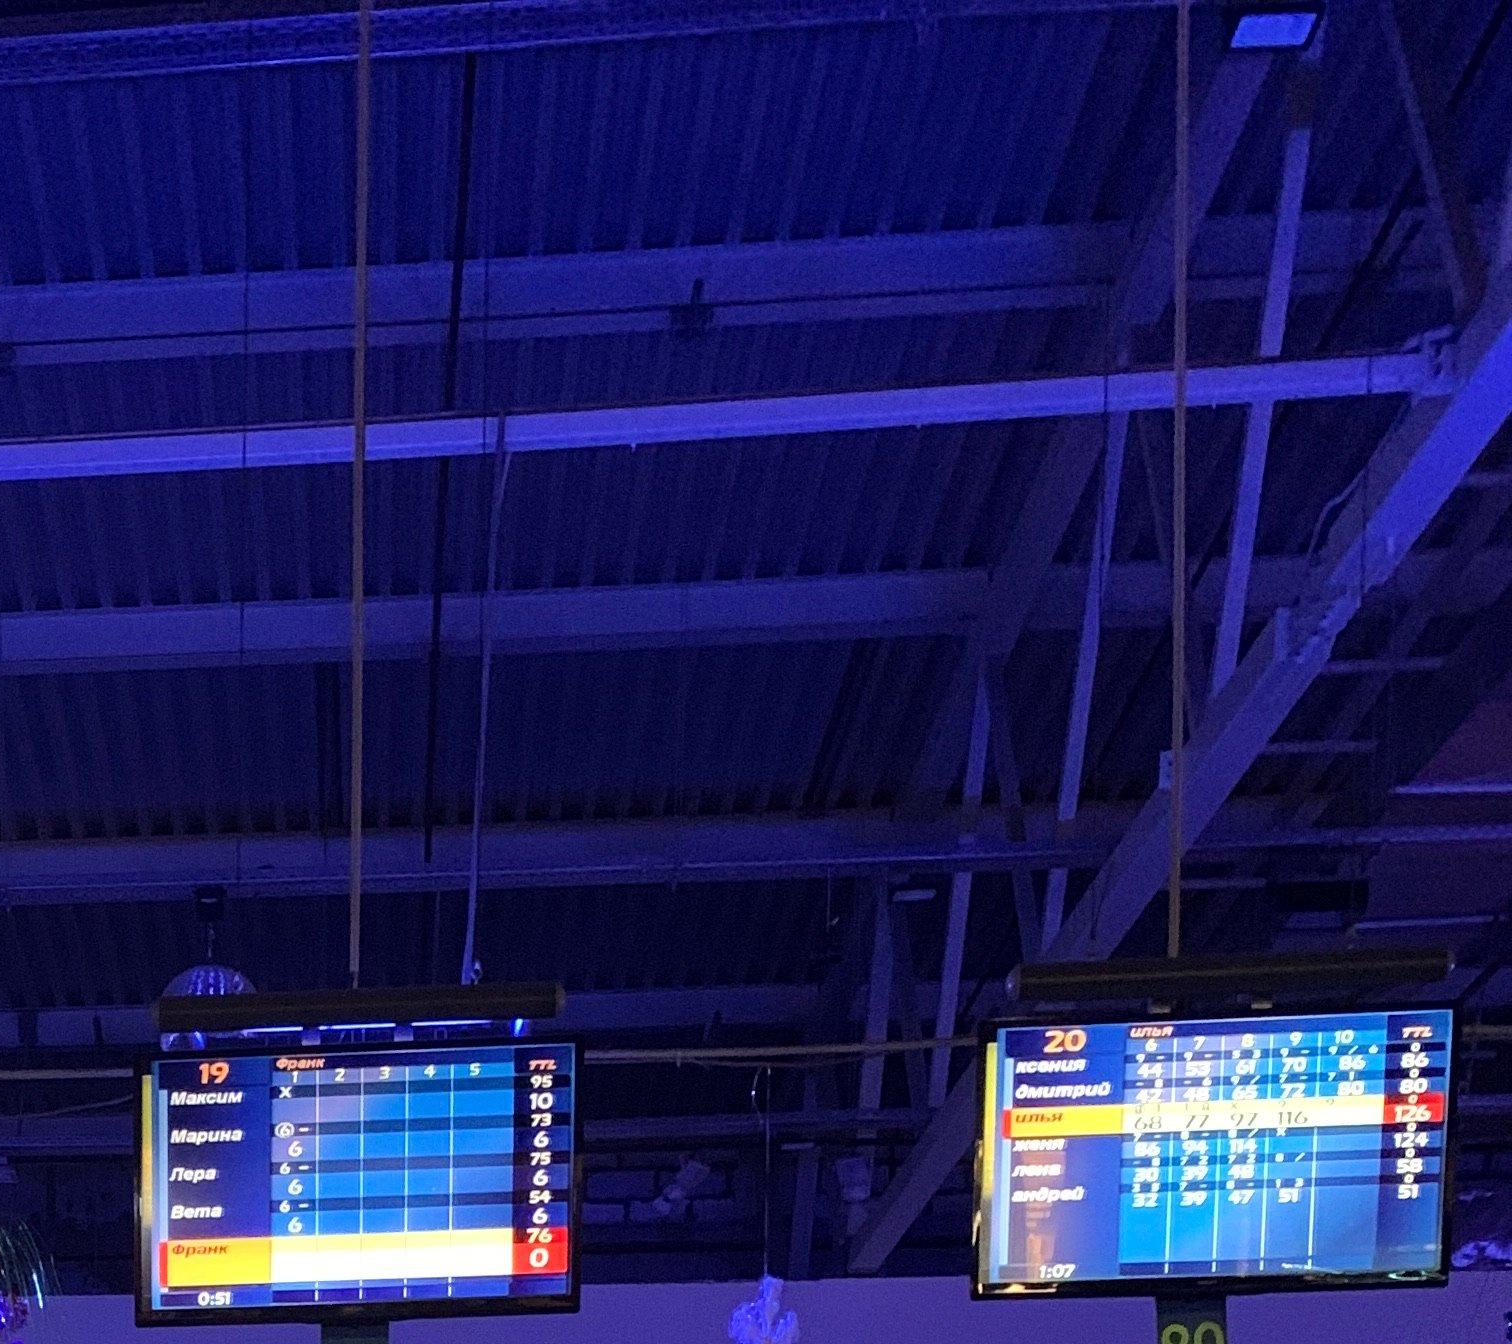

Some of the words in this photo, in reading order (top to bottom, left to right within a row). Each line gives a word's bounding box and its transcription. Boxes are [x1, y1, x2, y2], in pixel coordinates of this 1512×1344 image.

[1044, 1030, 1086, 1052] 20
[1335, 1030, 1353, 1044] 10
[277, 1058, 325, 1070] Франк
[528, 1060, 556, 1070] TTL
[1401, 1053, 1428, 1070] 86
[199, 1063, 228, 1084] 19
[530, 1076, 553, 1088] 95
[1400, 1078, 1427, 1095] 80
[170, 1091, 242, 1105] Максим
[1015, 1081, 1110, 1100] дмитрий
[530, 1093, 553, 1110] 10
[1394, 1103, 1430, 1121] 126
[532, 1115, 552, 1126] 73
[1134, 1115, 1162, 1130] 68
[1187, 1114, 1210, 1129] 77
[1230, 1112, 1258, 1127] 97
[1278, 1110, 1308, 1125] 116
[170, 1129, 242, 1144] Марина
[534, 1132, 549, 1148] 6
[1394, 1131, 1428, 1148] 124
[531, 1153, 551, 1165] 75
[1396, 1158, 1423, 1174] 58
[169, 1167, 216, 1182] Лера
[534, 1171, 548, 1186] 6
[529, 1191, 551, 1203] 54
[1397, 1184, 1419, 1199] 51
[171, 1205, 222, 1218] Вета
[533, 1209, 548, 1225] 6
[527, 1229, 552, 1244] 76
[172, 1244, 227, 1257] Франк
[530, 1249, 548, 1267] 0
[1038, 1264, 1076, 1278] 1:07
[198, 1292, 231, 1306] 0:51
